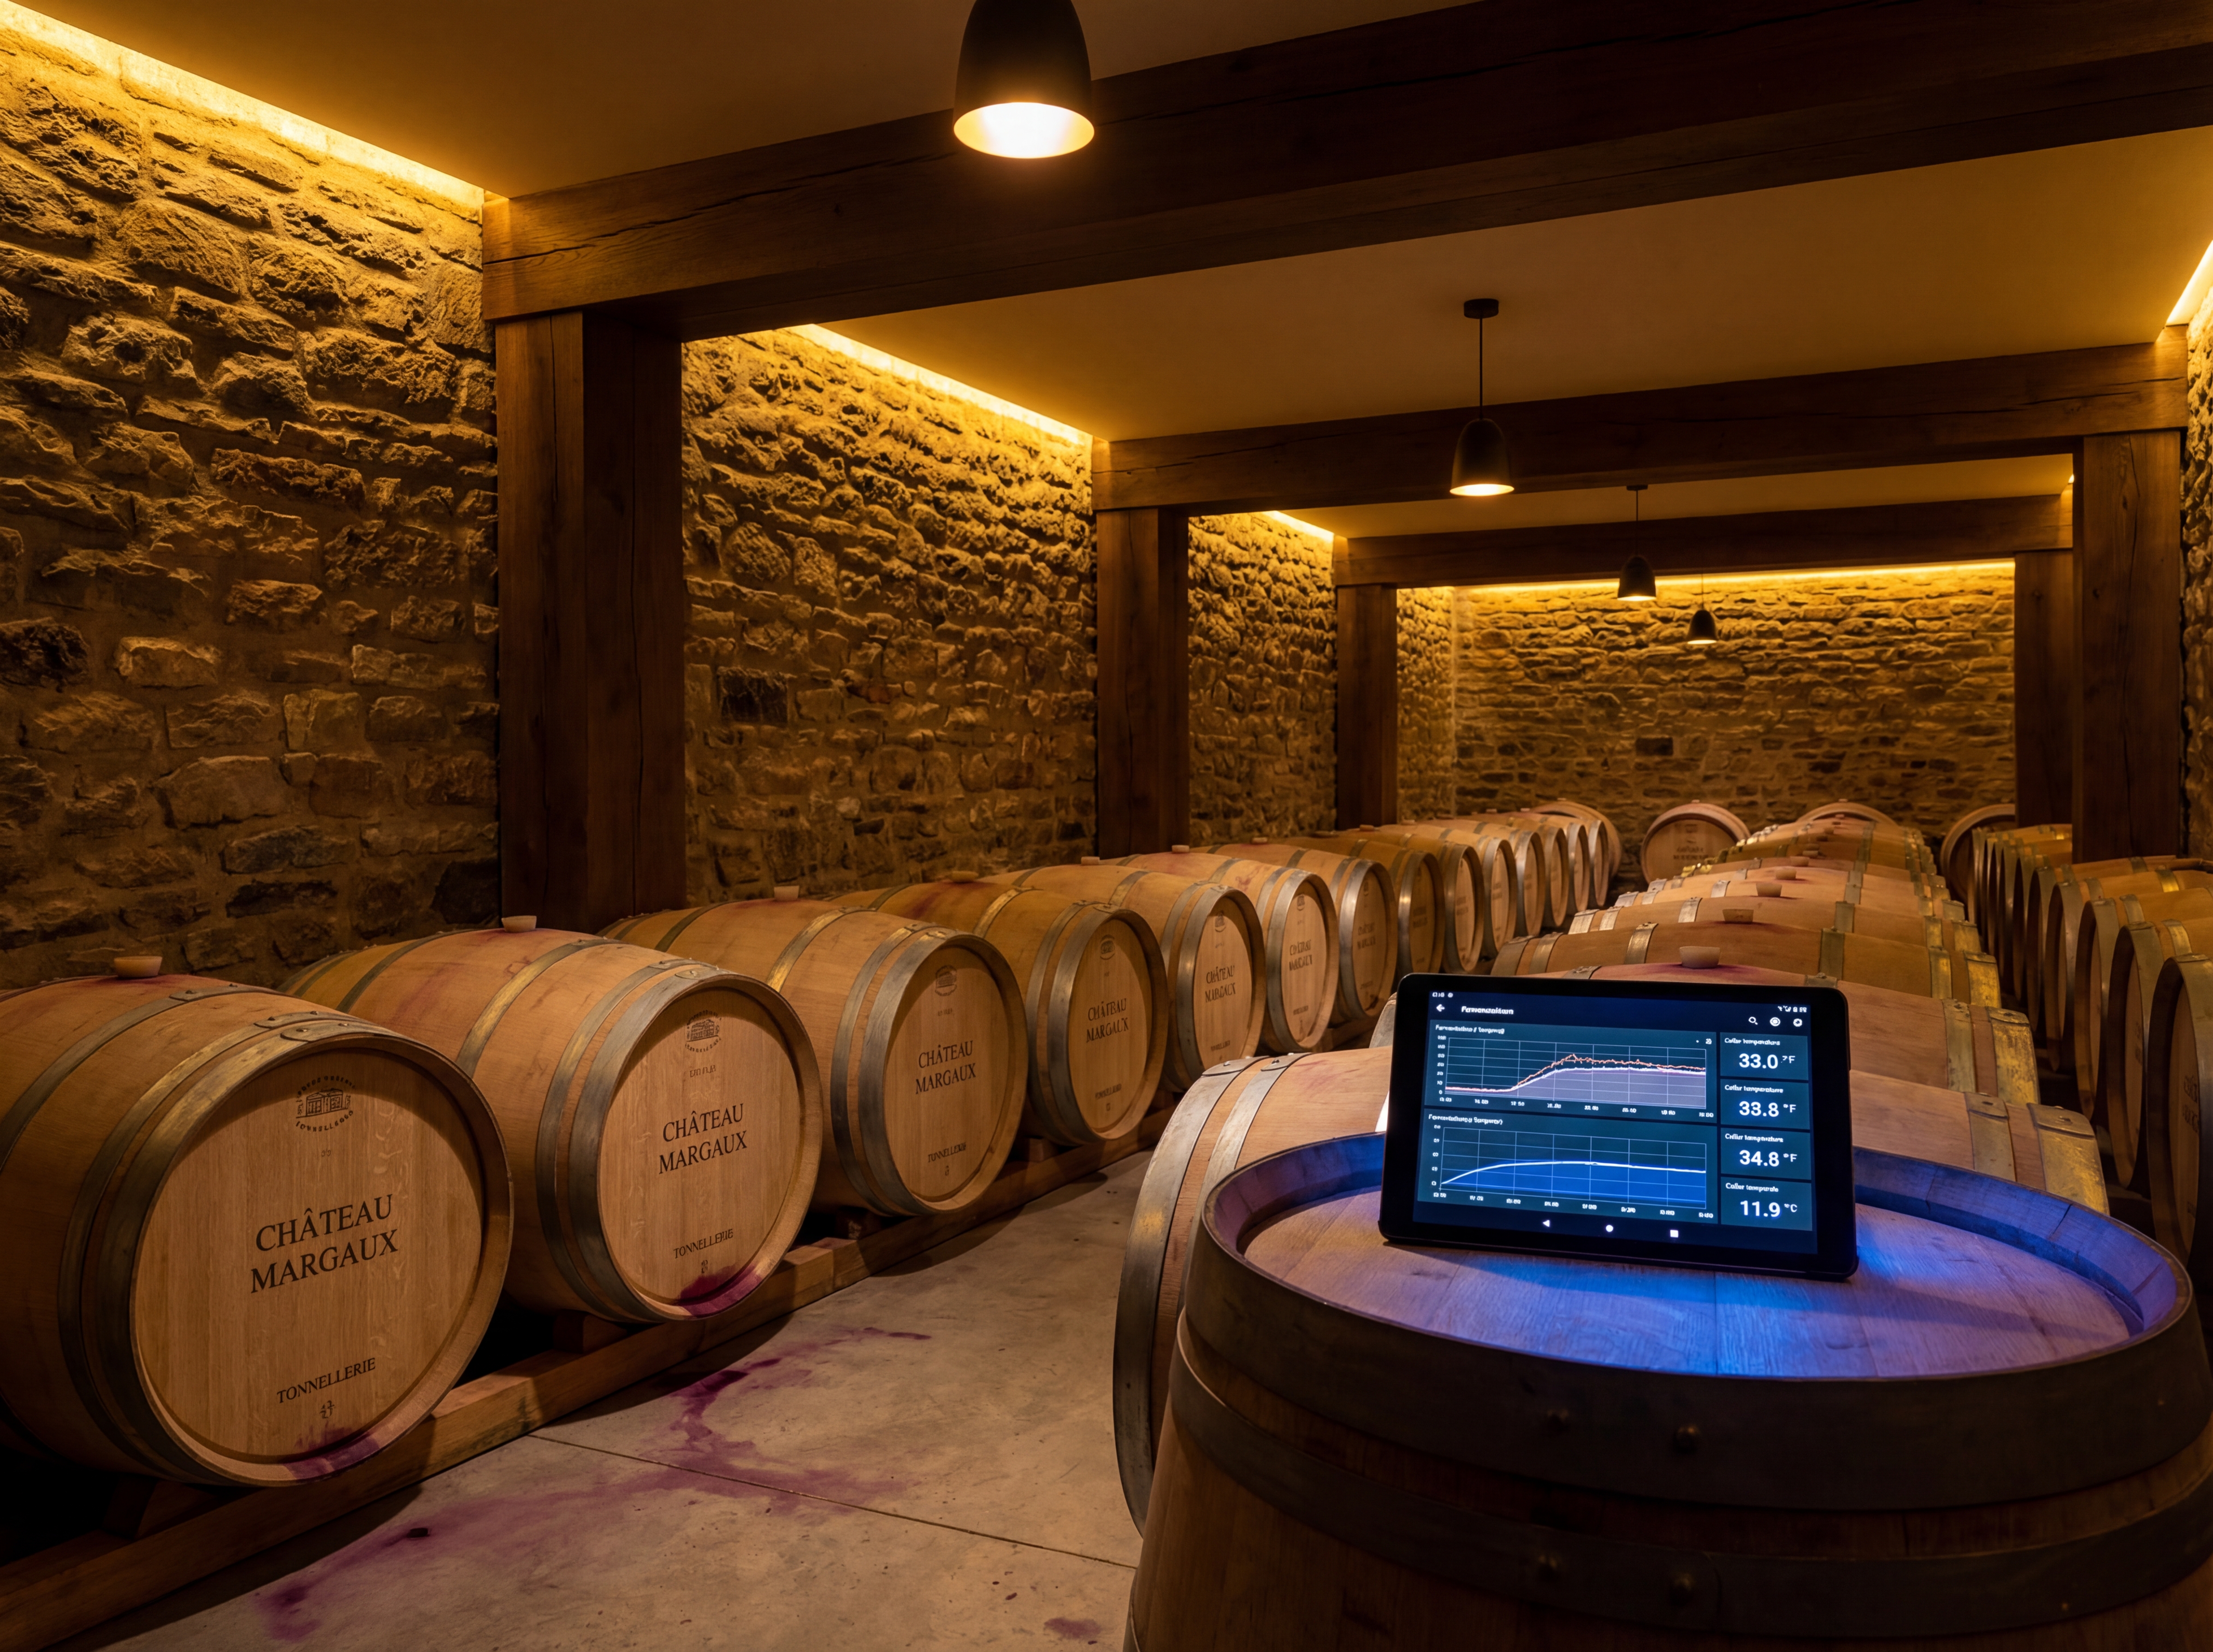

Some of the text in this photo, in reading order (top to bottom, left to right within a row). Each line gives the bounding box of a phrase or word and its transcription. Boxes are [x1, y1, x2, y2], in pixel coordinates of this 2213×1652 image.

[916, 1062, 976, 1095] MARGAUX
[1739, 1053, 1778, 1069] 33.0
[663, 1103, 744, 1142] CHÂTEAU
[1739, 1101, 1779, 1117] 33.8
[659, 1130, 747, 1174] MARGAUX
[1740, 1150, 1779, 1167] 34.8
[256, 1194, 392, 1251] CHÂTEAU
[1740, 1200, 1781, 1217] 11.9
[251, 1229, 398, 1293] MARGAUX
[277, 1357, 376, 1403] TONNELLERIE
